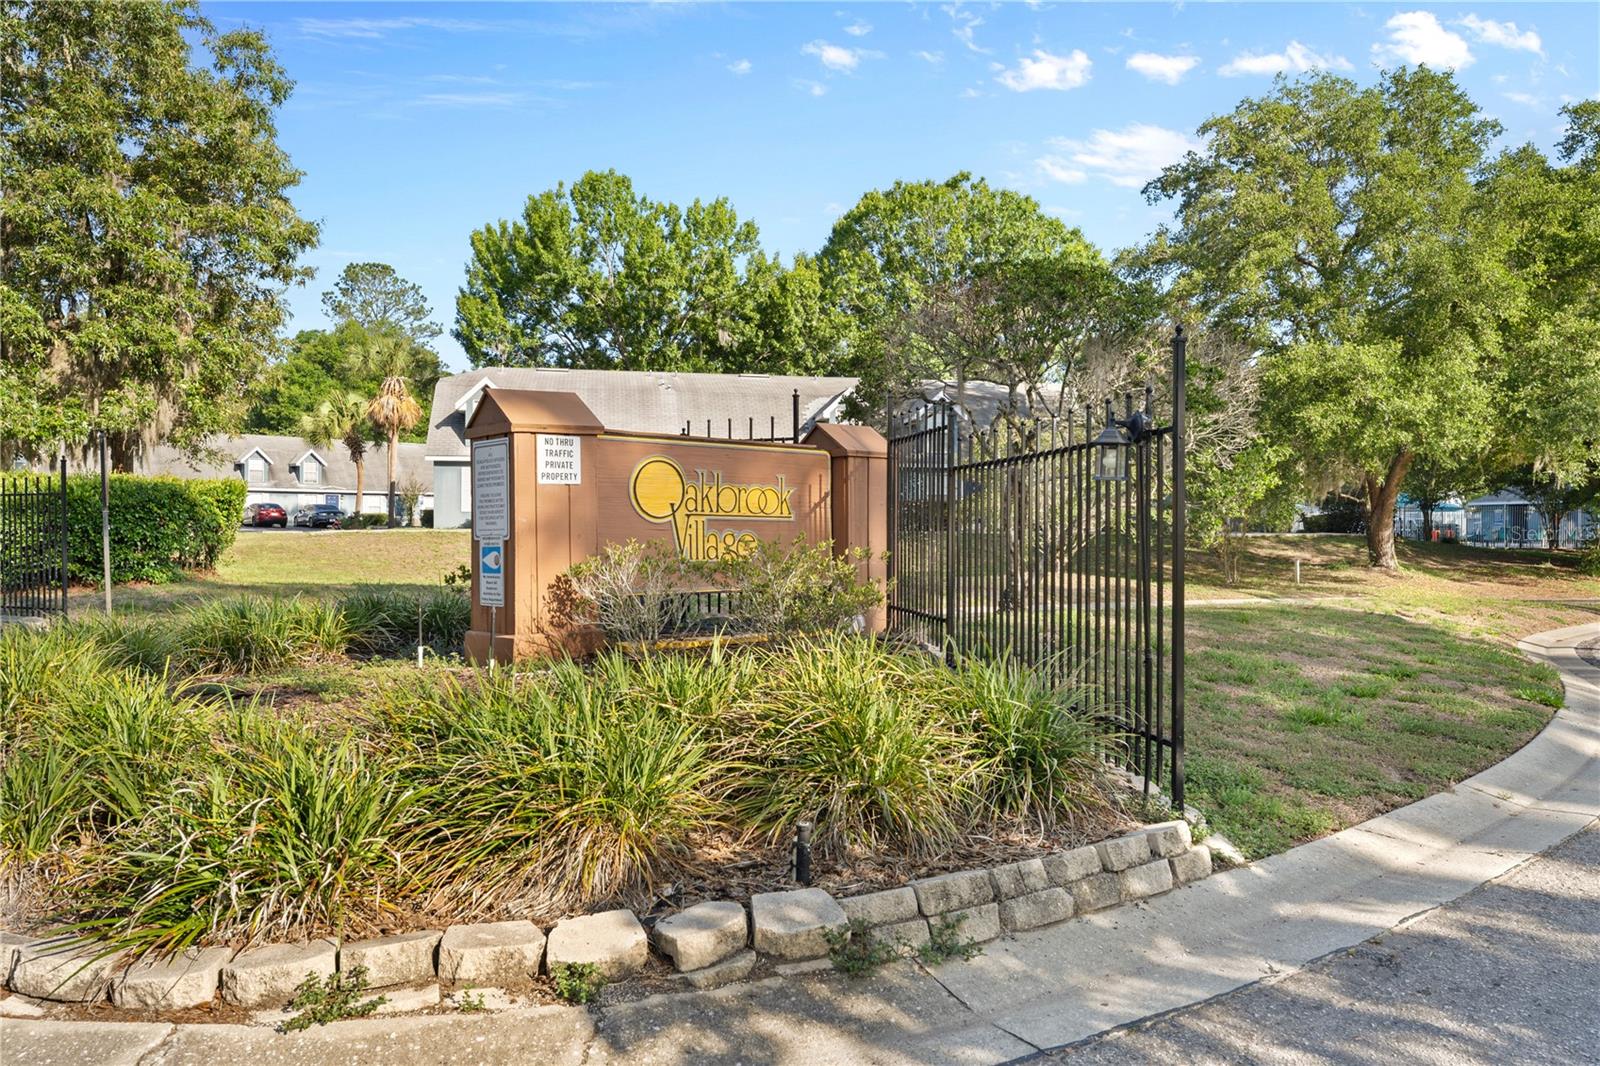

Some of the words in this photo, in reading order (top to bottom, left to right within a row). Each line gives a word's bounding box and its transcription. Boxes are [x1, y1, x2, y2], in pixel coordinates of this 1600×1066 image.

[544, 437, 554, 446] NO
[555, 437, 574, 447] THRU
[545, 449, 574, 458] TRAFFIC
[545, 460, 574, 470] PRIVATE
[541, 472, 578, 481] PROPERTY
[632, 458, 793, 518] Oakbrook
[669, 502, 757, 562] Village
